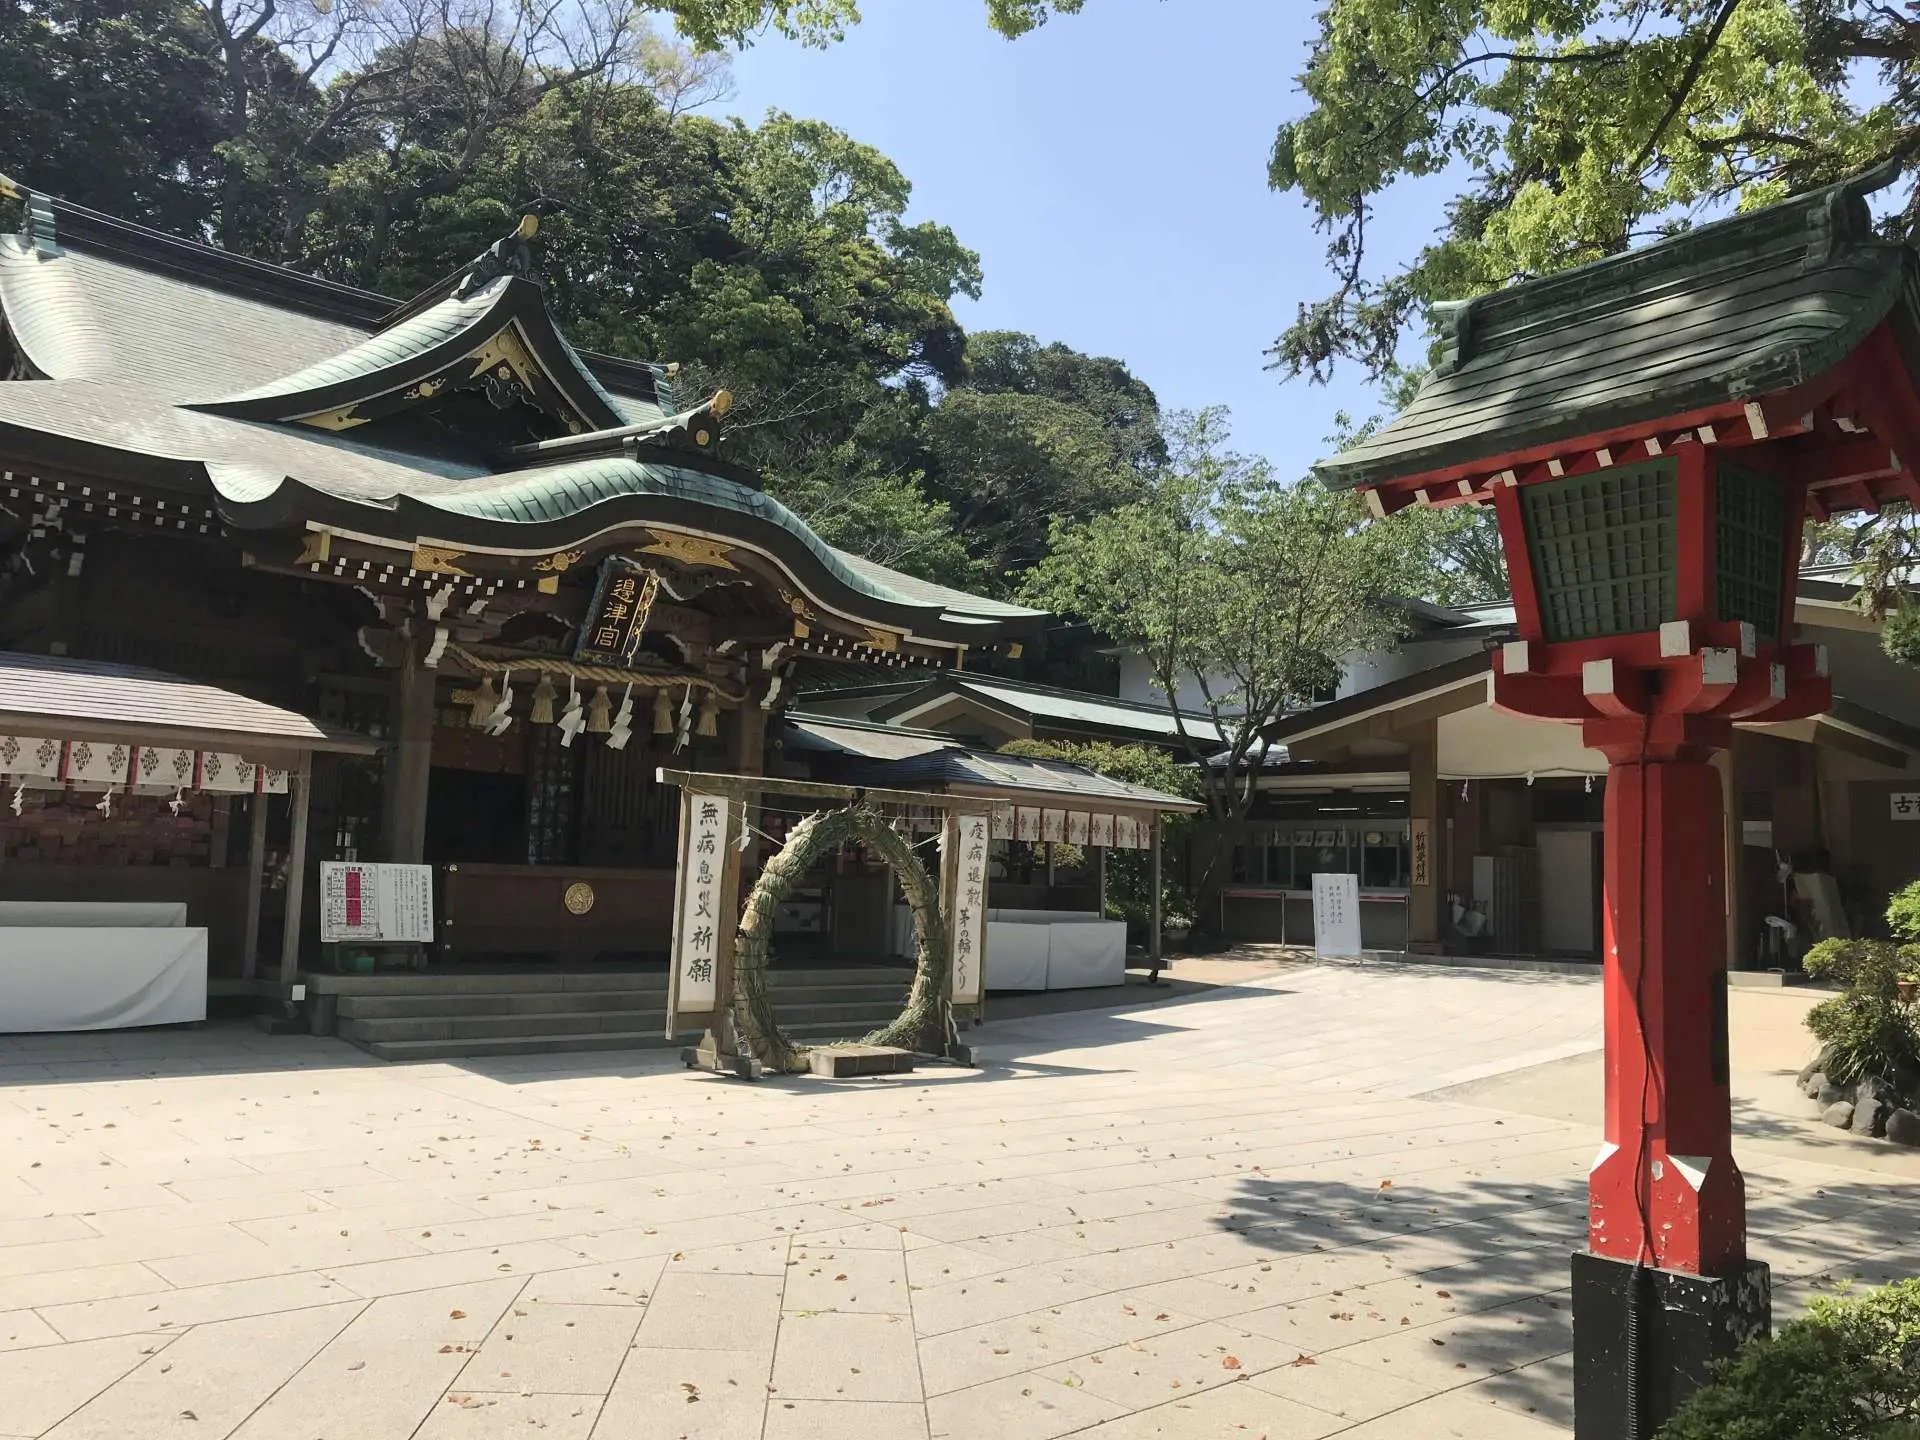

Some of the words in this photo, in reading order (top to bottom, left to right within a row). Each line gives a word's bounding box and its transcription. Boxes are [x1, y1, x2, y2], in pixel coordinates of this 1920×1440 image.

[686, 801, 720, 984] 無病息災祈願
[966, 821, 985, 908] 疫病退散
